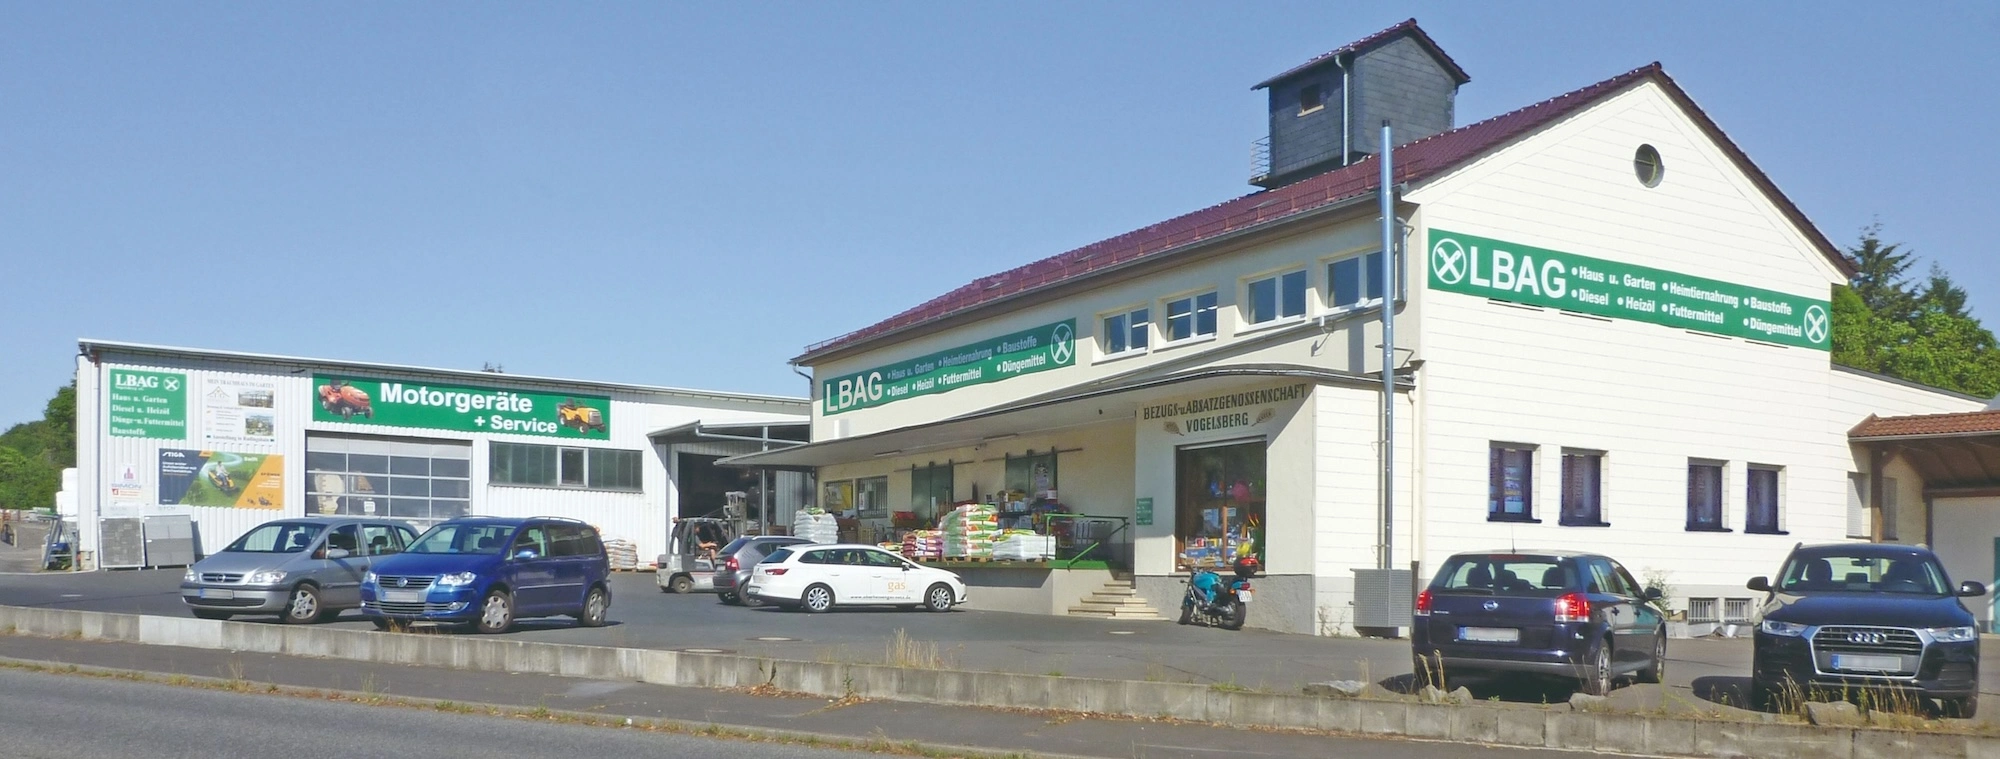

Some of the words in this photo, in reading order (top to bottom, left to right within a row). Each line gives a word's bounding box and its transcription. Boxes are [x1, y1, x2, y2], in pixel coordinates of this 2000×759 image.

[1470, 245, 1567, 299] LBAG
[1579, 265, 1604, 283] Haus
[1609, 274, 1619, 285] u.
[1623, 273, 1656, 291] Garten
[1669, 281, 1739, 308] Heimtiernahrung
[1750, 297, 1792, 316] Baustoffe
[1579, 288, 1609, 306] Diesel
[1625, 296, 1656, 313] Heizöl
[1669, 303, 1724, 324] Futtermittel
[1750, 317, 1802, 337] Düngemittel
[891, 369, 906, 380] Haus
[914, 361, 935, 375] Garten
[943, 348, 993, 367] Heimtiernahrung
[1002, 336, 1038, 354] Baustoffe
[115, 373, 159, 388] LBAG
[891, 383, 909, 397] Diesel
[916, 377, 935, 391] Heizöl
[942, 366, 982, 386] Futtermittel
[1002, 352, 1046, 373] Düngemittel
[112, 393, 131, 401] Haus
[143, 395, 168, 403] Garten
[380, 382, 533, 414] Motorgeräte
[825, 371, 883, 412] LBAG
[112, 404, 134, 412] Diesel
[146, 406, 170, 415] Heizöl
[1185, 412, 1249, 433] VOGELSBERG
[112, 427, 146, 435] Baustoffe
[474, 415, 486, 427] +
[490, 414, 558, 434] Service
[887, 581, 906, 593] gas
